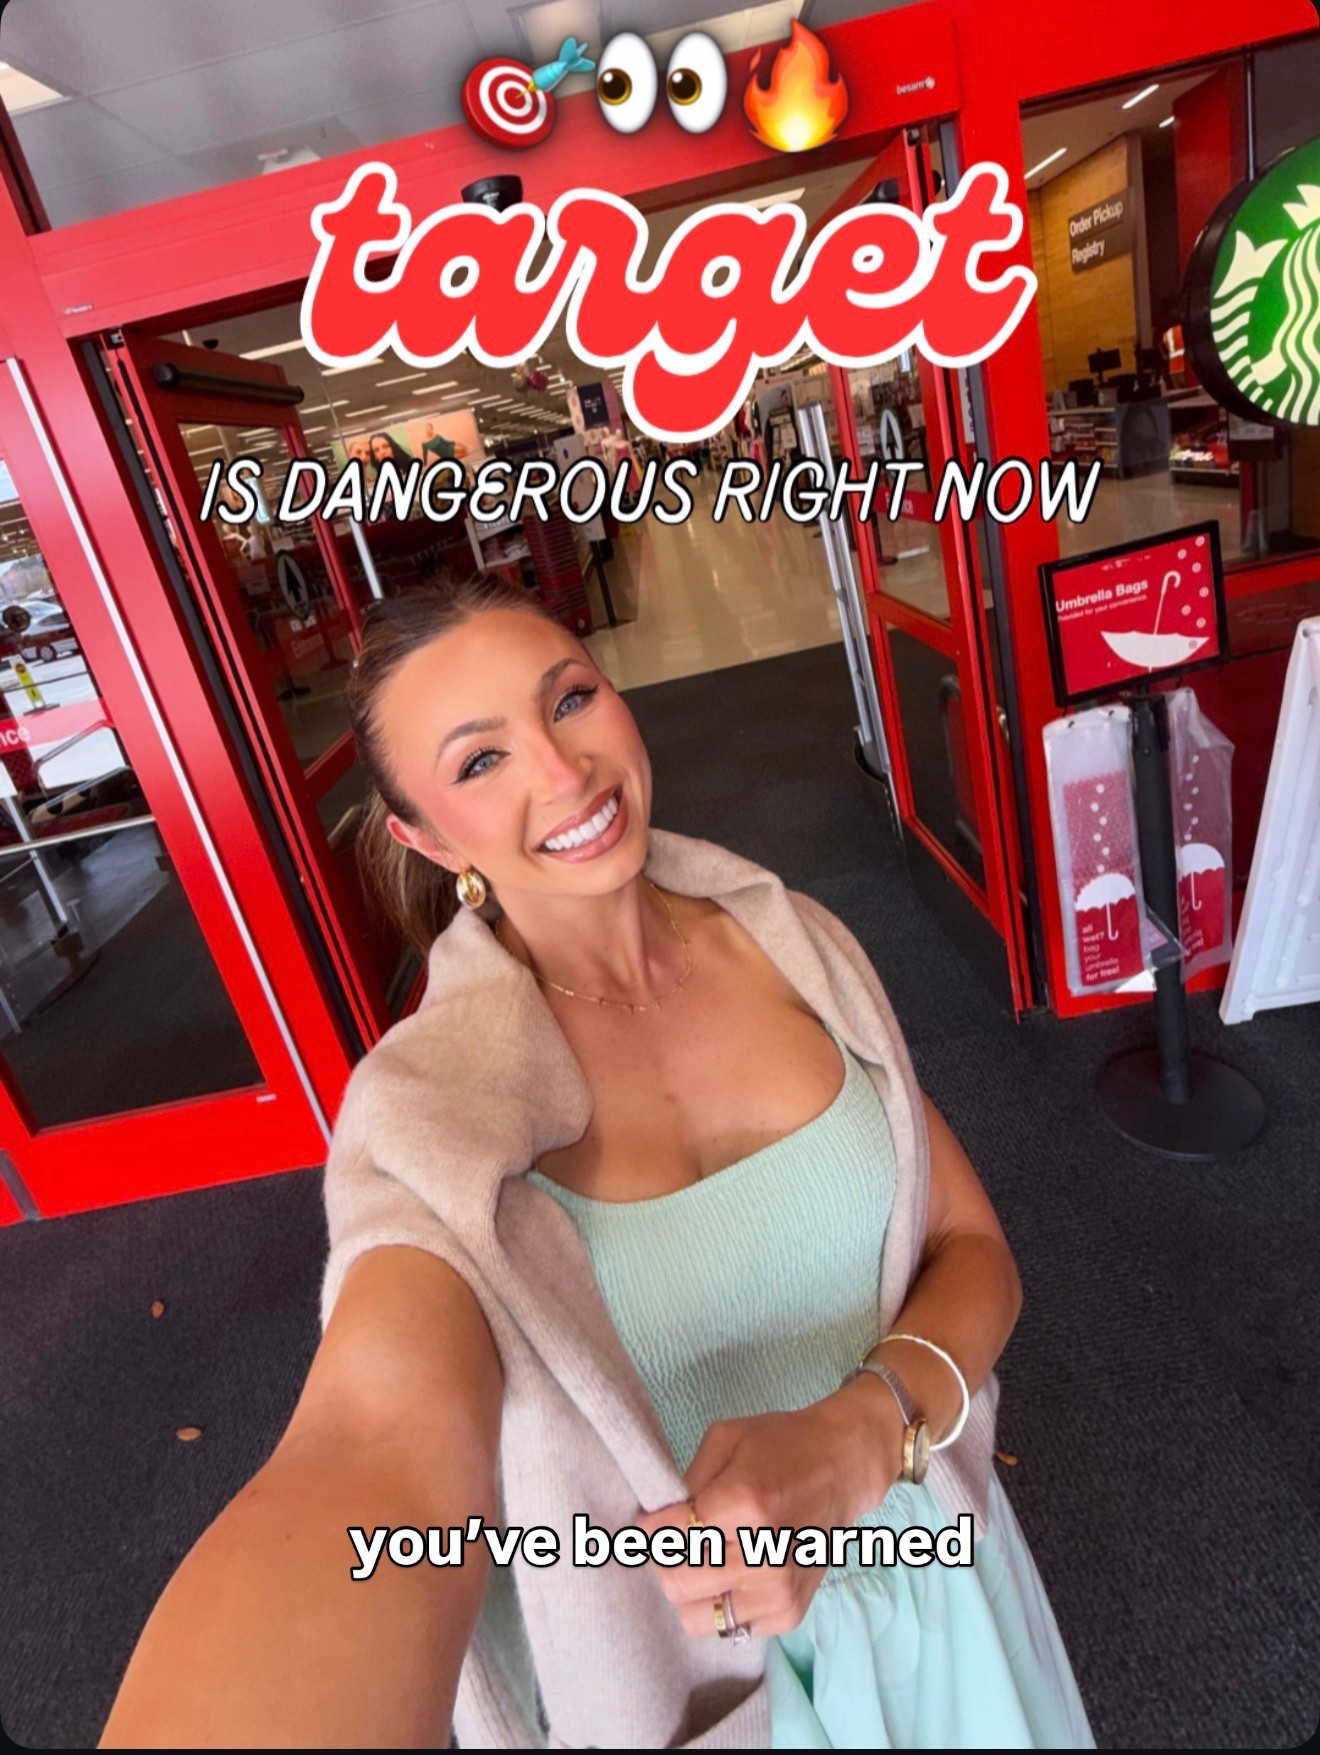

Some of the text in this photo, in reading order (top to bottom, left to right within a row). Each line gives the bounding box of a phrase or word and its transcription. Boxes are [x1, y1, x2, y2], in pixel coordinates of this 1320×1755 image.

[1070, 201, 1123, 237] Order Pickup
[1072, 240, 1105, 264] Registry
[1055, 580, 1149, 612] Umbrella Bags
[1085, 607, 1094, 616] for
[1095, 605, 1108, 615] your
[1082, 923, 1094, 934] all
[1082, 931, 1105, 943] wet?
[1084, 953, 1102, 964] your
[1086, 965, 1120, 981] for free!
